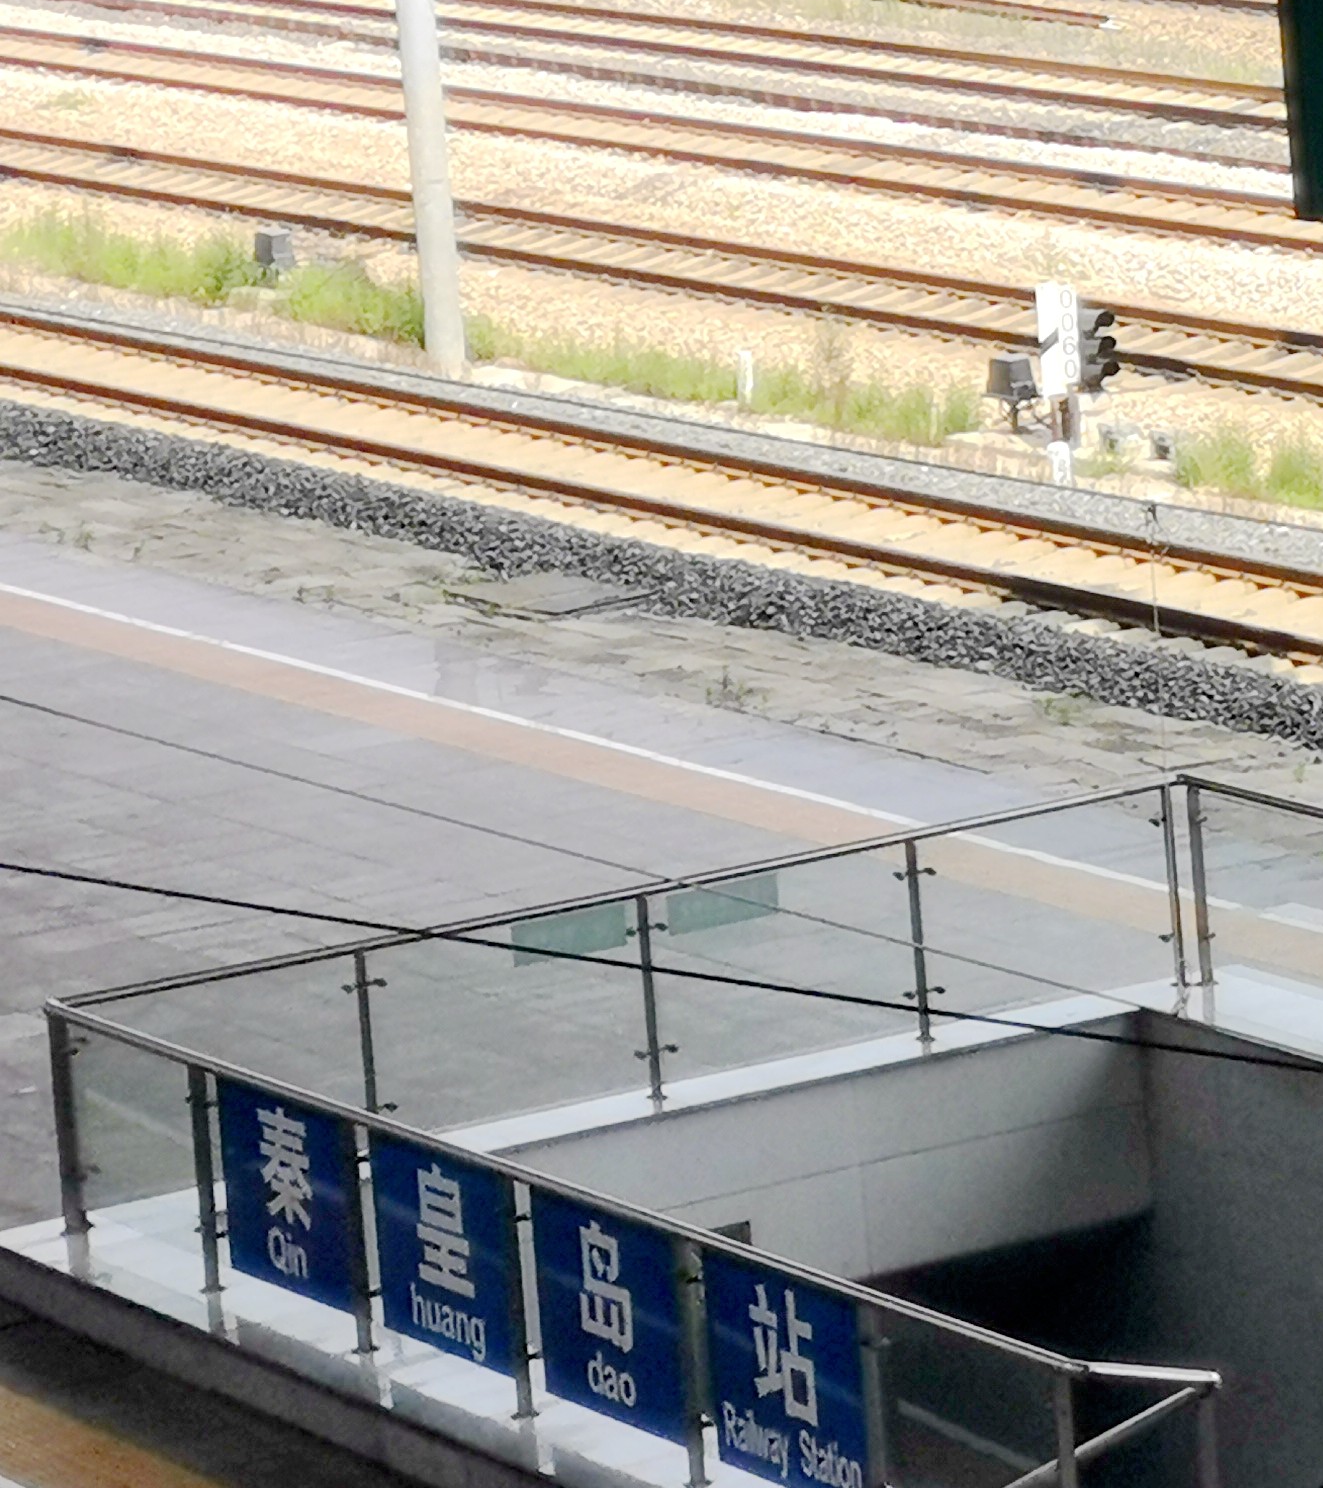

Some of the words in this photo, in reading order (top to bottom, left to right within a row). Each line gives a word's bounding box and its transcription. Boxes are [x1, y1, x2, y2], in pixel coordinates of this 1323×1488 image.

[268, 1226, 309, 1279] Qin
[411, 1282, 487, 1364] huang
[587, 1352, 637, 1407] dao
[721, 1400, 789, 1479] Railway
[799, 1429, 863, 1488] Station
